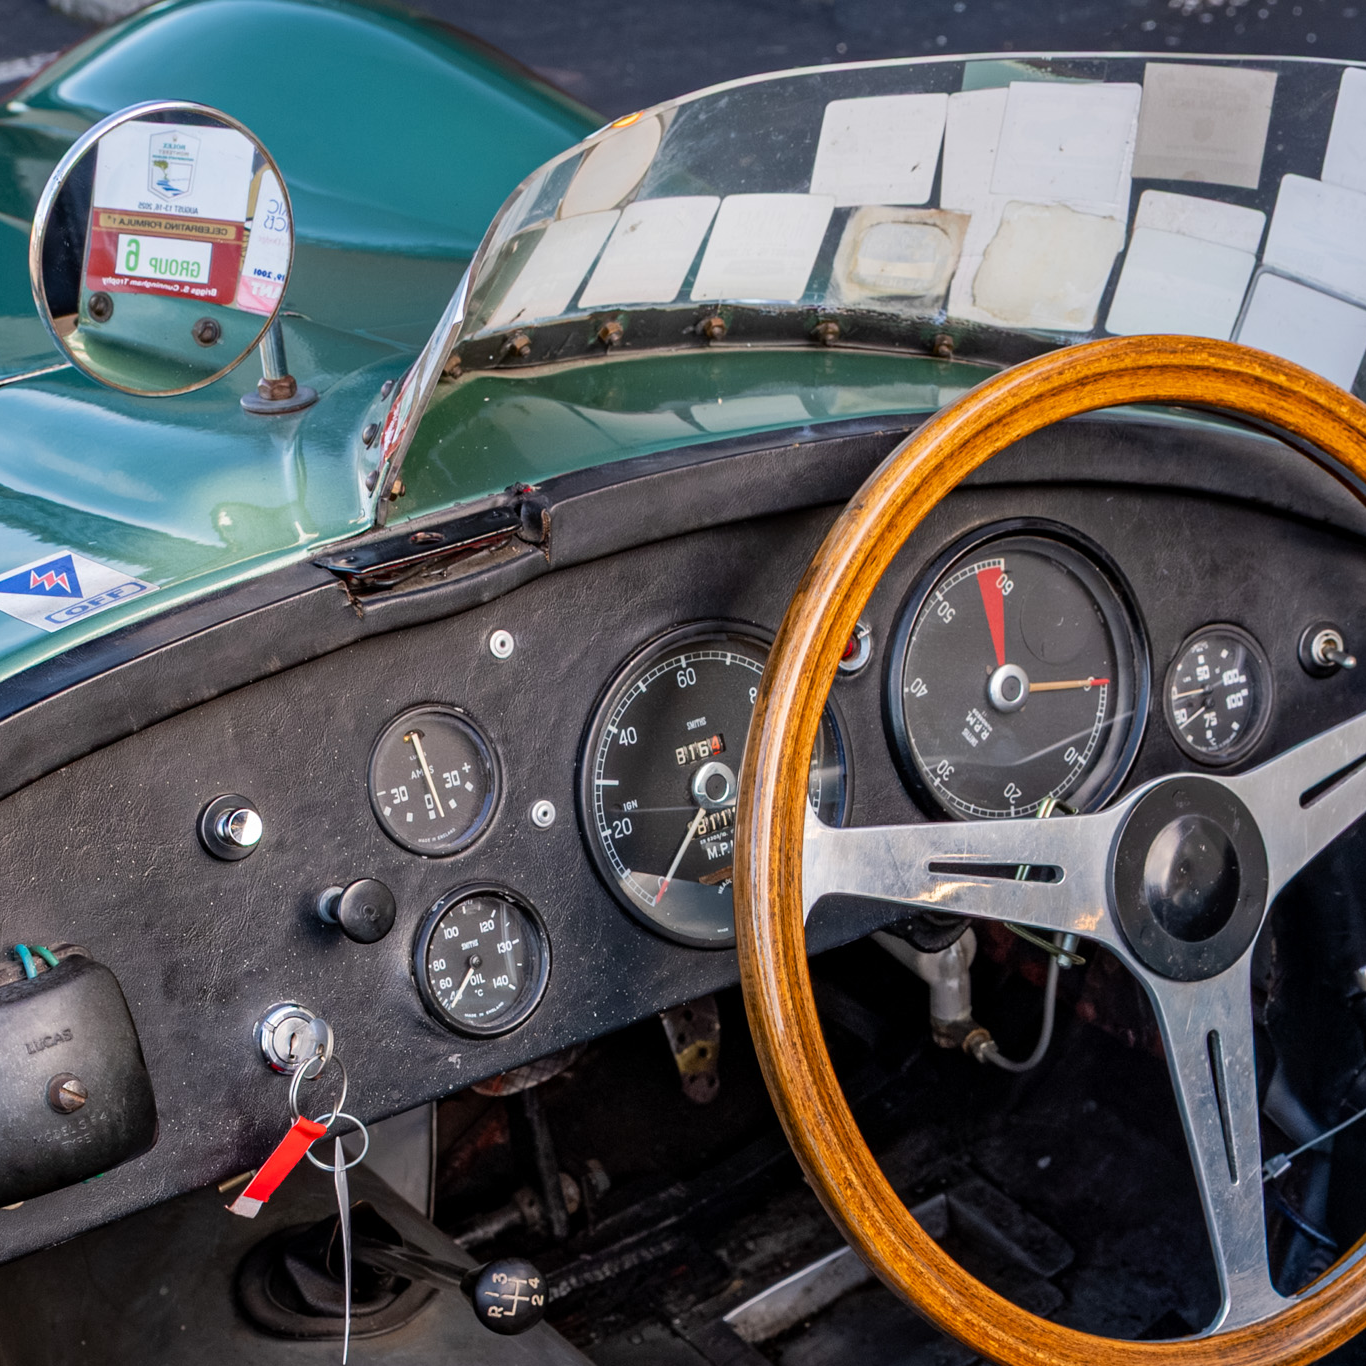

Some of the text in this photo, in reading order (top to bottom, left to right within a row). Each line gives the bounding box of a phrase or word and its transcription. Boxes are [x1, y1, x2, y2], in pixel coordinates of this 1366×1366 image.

[995, 573, 1015, 596] 60
[64, 588, 124, 616] OFF
[937, 601, 956, 624] 50
[676, 668, 697, 688] 60
[1196, 665, 1210, 682] 50
[749, 687, 758, 704] 8
[910, 677, 928, 698] 40
[686, 717, 707, 731] SMITHS
[965, 710, 991, 741] R.P.M.
[1203, 711, 1218, 728] 75
[619, 727, 638, 747] 40
[961, 727, 979, 748] SMITHS
[1063, 746, 1080, 766] 10
[411, 765, 434, 779] AMS
[937, 759, 955, 782] 30
[442, 770, 460, 789] 30
[391, 785, 409, 804] 30
[424, 793, 434, 809] 0
[1004, 782, 1022, 804] 20
[623, 799, 638, 812] IGN
[437, 827, 456, 840] ENGLAND
[612, 817, 633, 838] 20
[443, 926, 459, 939] 100
[479, 920, 495, 933] 120
[461, 939, 479, 951] SMITHS
[497, 941, 513, 954] 130
[433, 958, 446, 972] 80
[440, 977, 453, 989] 60
[470, 973, 486, 986] OIL
[493, 975, 509, 988] 140
[486, 1001, 504, 1015] ENGLAND
[25, 1028, 74, 1055] LUCAS
[492, 1273, 508, 1285] 3
[528, 1277, 540, 1289] 4
[531, 1294, 544, 1306] 2
[487, 1305, 504, 1318] R
